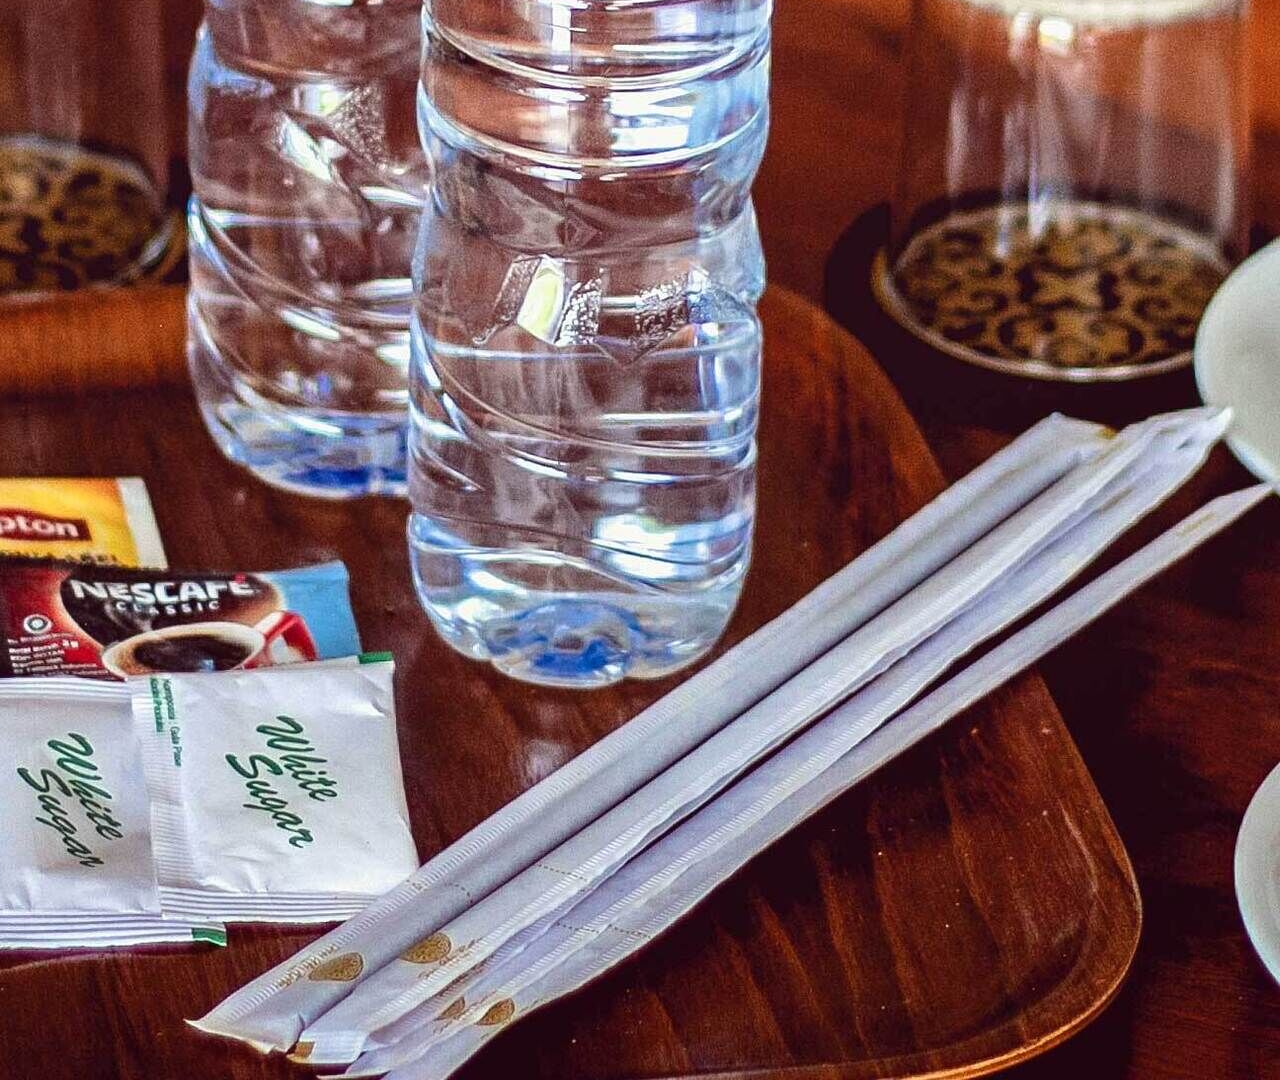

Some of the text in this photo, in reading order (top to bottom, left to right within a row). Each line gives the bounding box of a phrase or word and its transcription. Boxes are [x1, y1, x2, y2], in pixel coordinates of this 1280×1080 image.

[116, 600, 220, 615] CLASSIC
[47, 732, 123, 840] White
[225, 753, 317, 849] Sugar
[256, 715, 338, 802] White
[17, 766, 104, 868] Sugar
